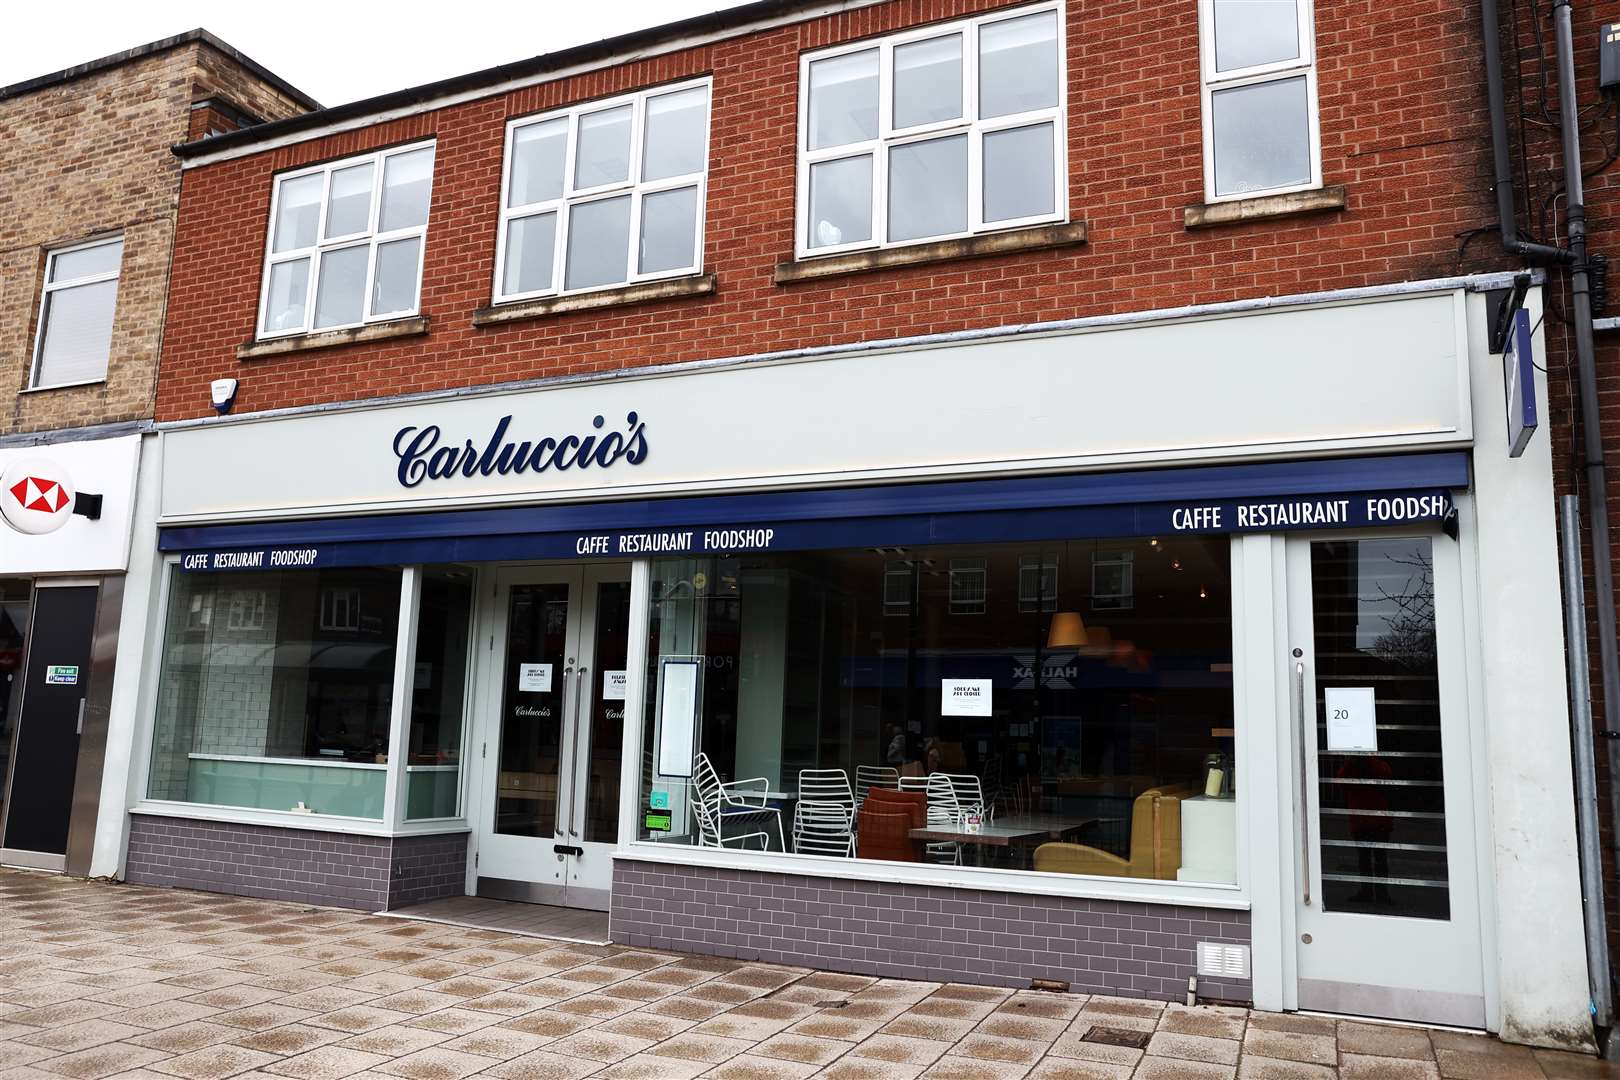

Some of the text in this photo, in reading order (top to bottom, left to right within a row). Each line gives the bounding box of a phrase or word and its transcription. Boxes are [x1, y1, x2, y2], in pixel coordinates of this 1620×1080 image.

[393, 411, 648, 488] Carluccio's
[1172, 506, 1221, 530] CAFFE
[1237, 500, 1349, 527] RESTAURANT
[576, 529, 774, 554] CAFFE RESTAURANT FOODSHOP
[184, 549, 318, 569] CAFFE RESTAURANT FOODSHOP
[1334, 709, 1349, 720] 20
